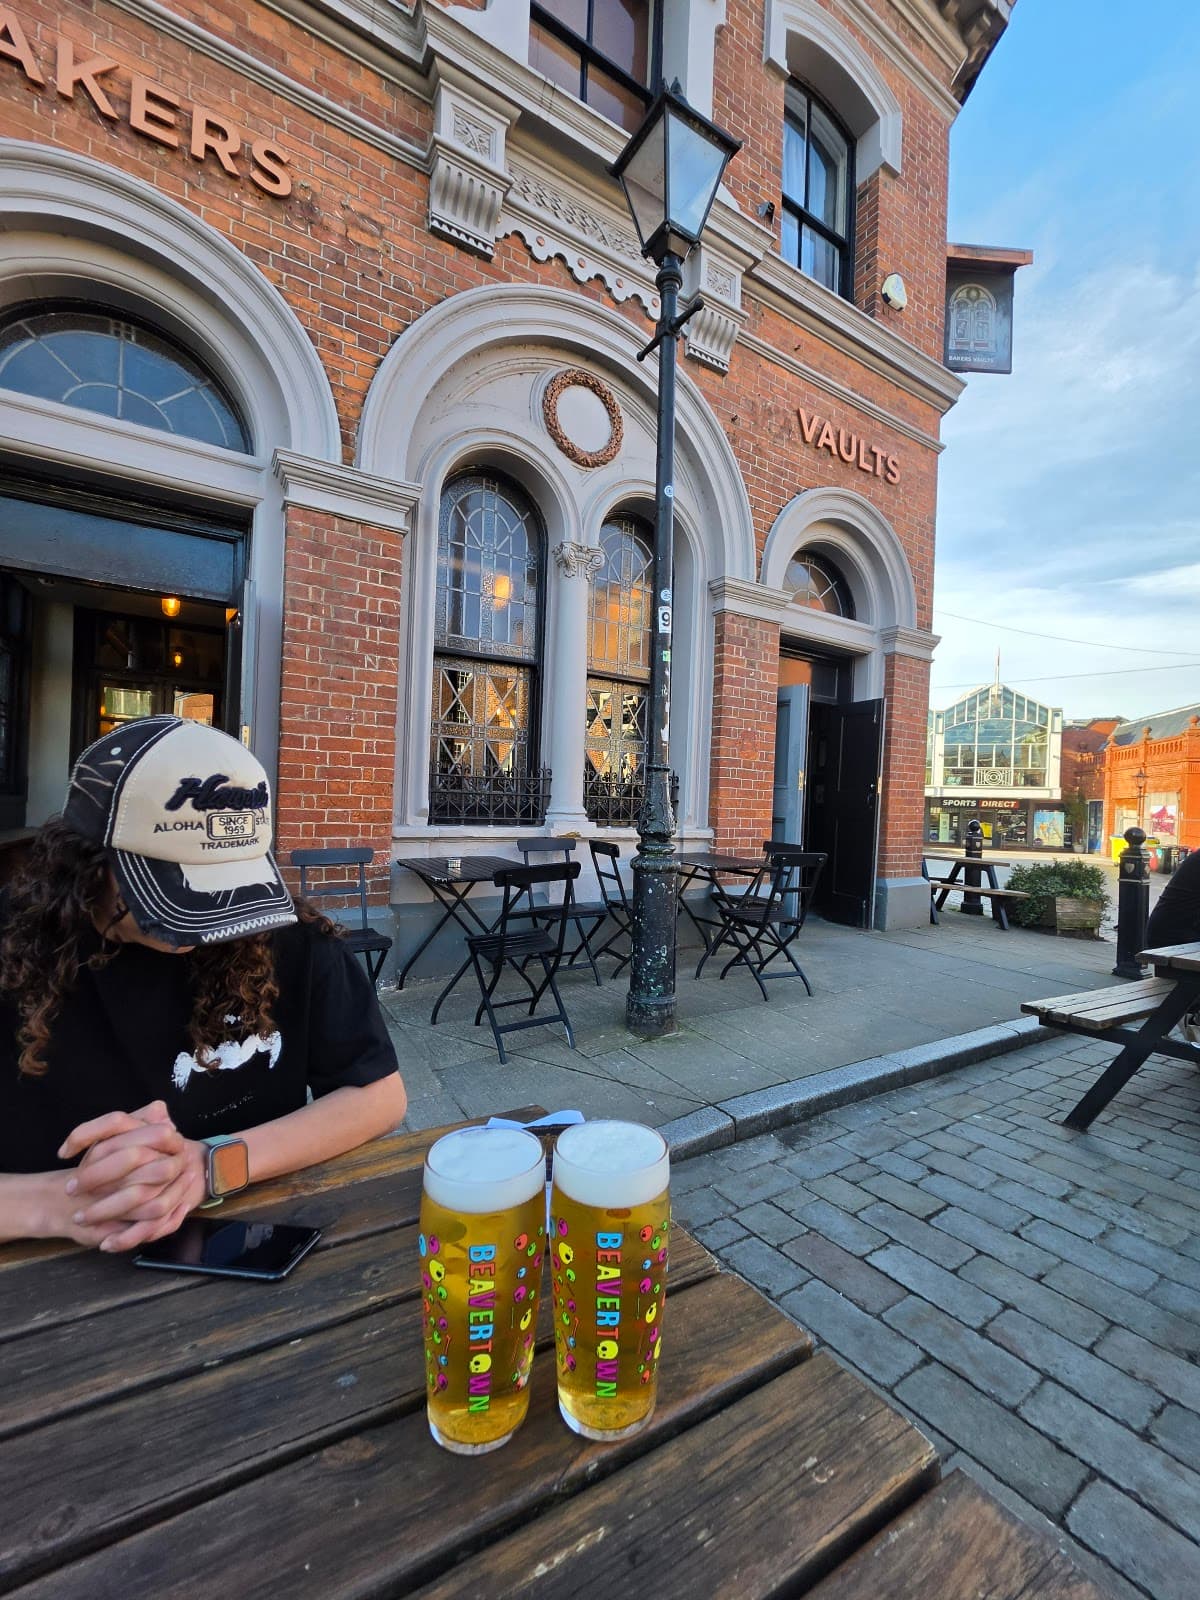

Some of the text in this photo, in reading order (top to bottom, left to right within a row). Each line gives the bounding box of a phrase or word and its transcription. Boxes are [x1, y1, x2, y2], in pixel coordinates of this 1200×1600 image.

[0, 5, 292, 198] AKERS
[797, 407, 900, 485] VAULTS
[942, 799, 1017, 808] SPORTS DIRECT
[153, 821, 205, 833] ALOHA
[218, 816, 249, 826] SINCE
[223, 825, 245, 835] 1959
[200, 837, 259, 850] TRADEMARK
[595, 1231, 623, 1398] BEAVERTOWN
[468, 1243, 496, 1413] BEAVERTOWN
